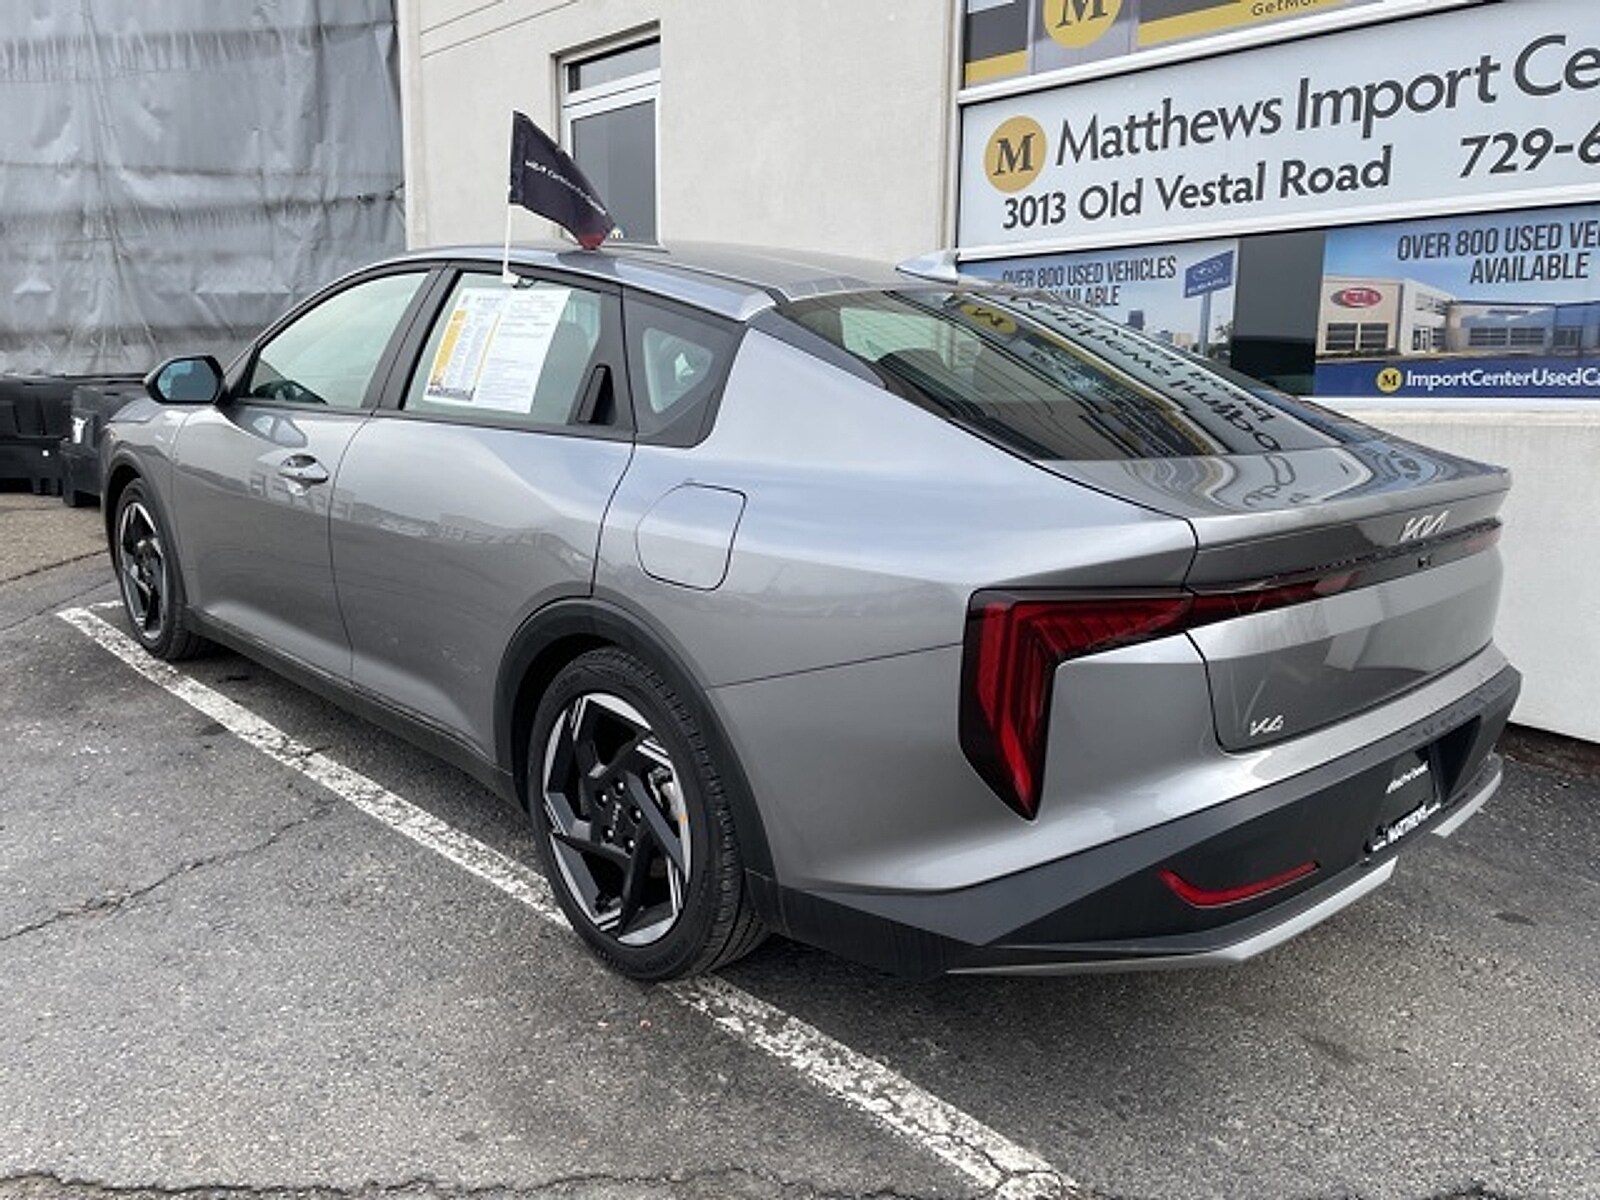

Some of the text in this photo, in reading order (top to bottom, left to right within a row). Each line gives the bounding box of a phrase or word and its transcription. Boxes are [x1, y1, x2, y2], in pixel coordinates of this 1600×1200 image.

[1056, 34, 1600, 166] Matthews Import Ce
[993, 133, 1035, 176] M
[1003, 120, 1600, 230] 3013 Old Vestal Road 729-6
[1397, 232, 1450, 261] OVER
[1455, 227, 1499, 256] 800
[1505, 222, 1562, 253] USED
[1038, 265, 1064, 288] 800
[1068, 262, 1102, 286] USED
[1107, 255, 1176, 282] VEHICLES
[1470, 252, 1590, 284] AVAILABLE
[1407, 366, 1600, 390] ImportCenterUsedC
